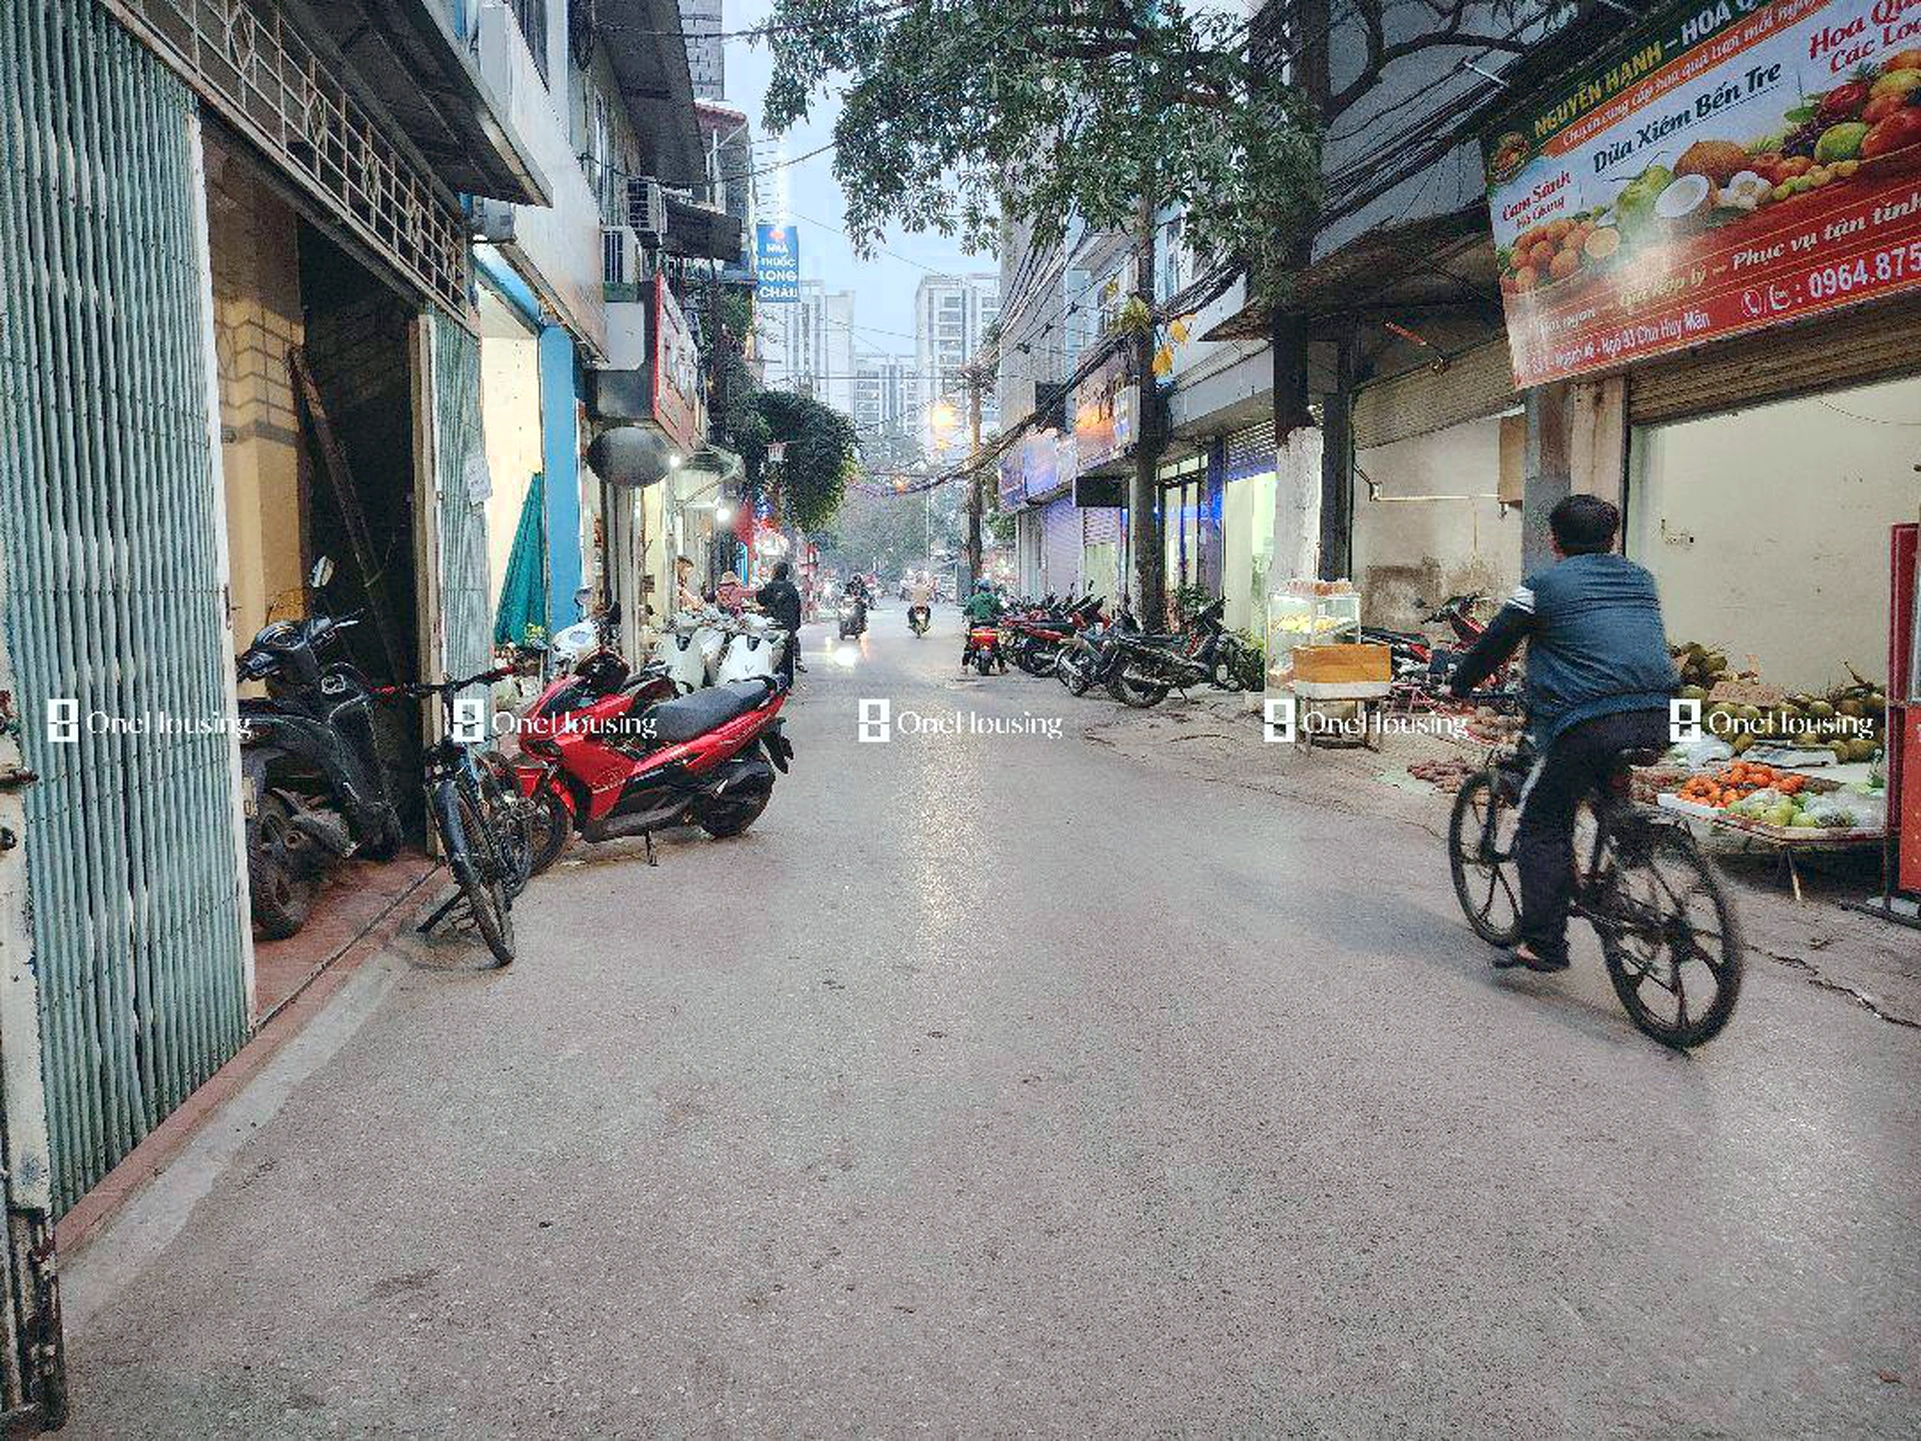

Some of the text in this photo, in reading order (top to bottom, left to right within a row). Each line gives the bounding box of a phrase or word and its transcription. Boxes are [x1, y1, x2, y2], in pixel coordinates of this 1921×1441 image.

[1681, 0, 1732, 46] HOA
[1809, 16, 1867, 60] Hoa
[1830, 36, 1876, 74] Các
[1694, 81, 1743, 120] Bến
[1745, 63, 1782, 94] Tre
[1503, 198, 1532, 221] Cam
[1732, 243, 1785, 271] Phục
[1791, 232, 1818, 252] vụ
[1824, 217, 1867, 243] tận
[759, 270, 797, 282] LONG
[760, 283, 798, 298] CHÂU
[1636, 324, 1660, 345] Chu
[1660, 317, 1682, 341] Huy
